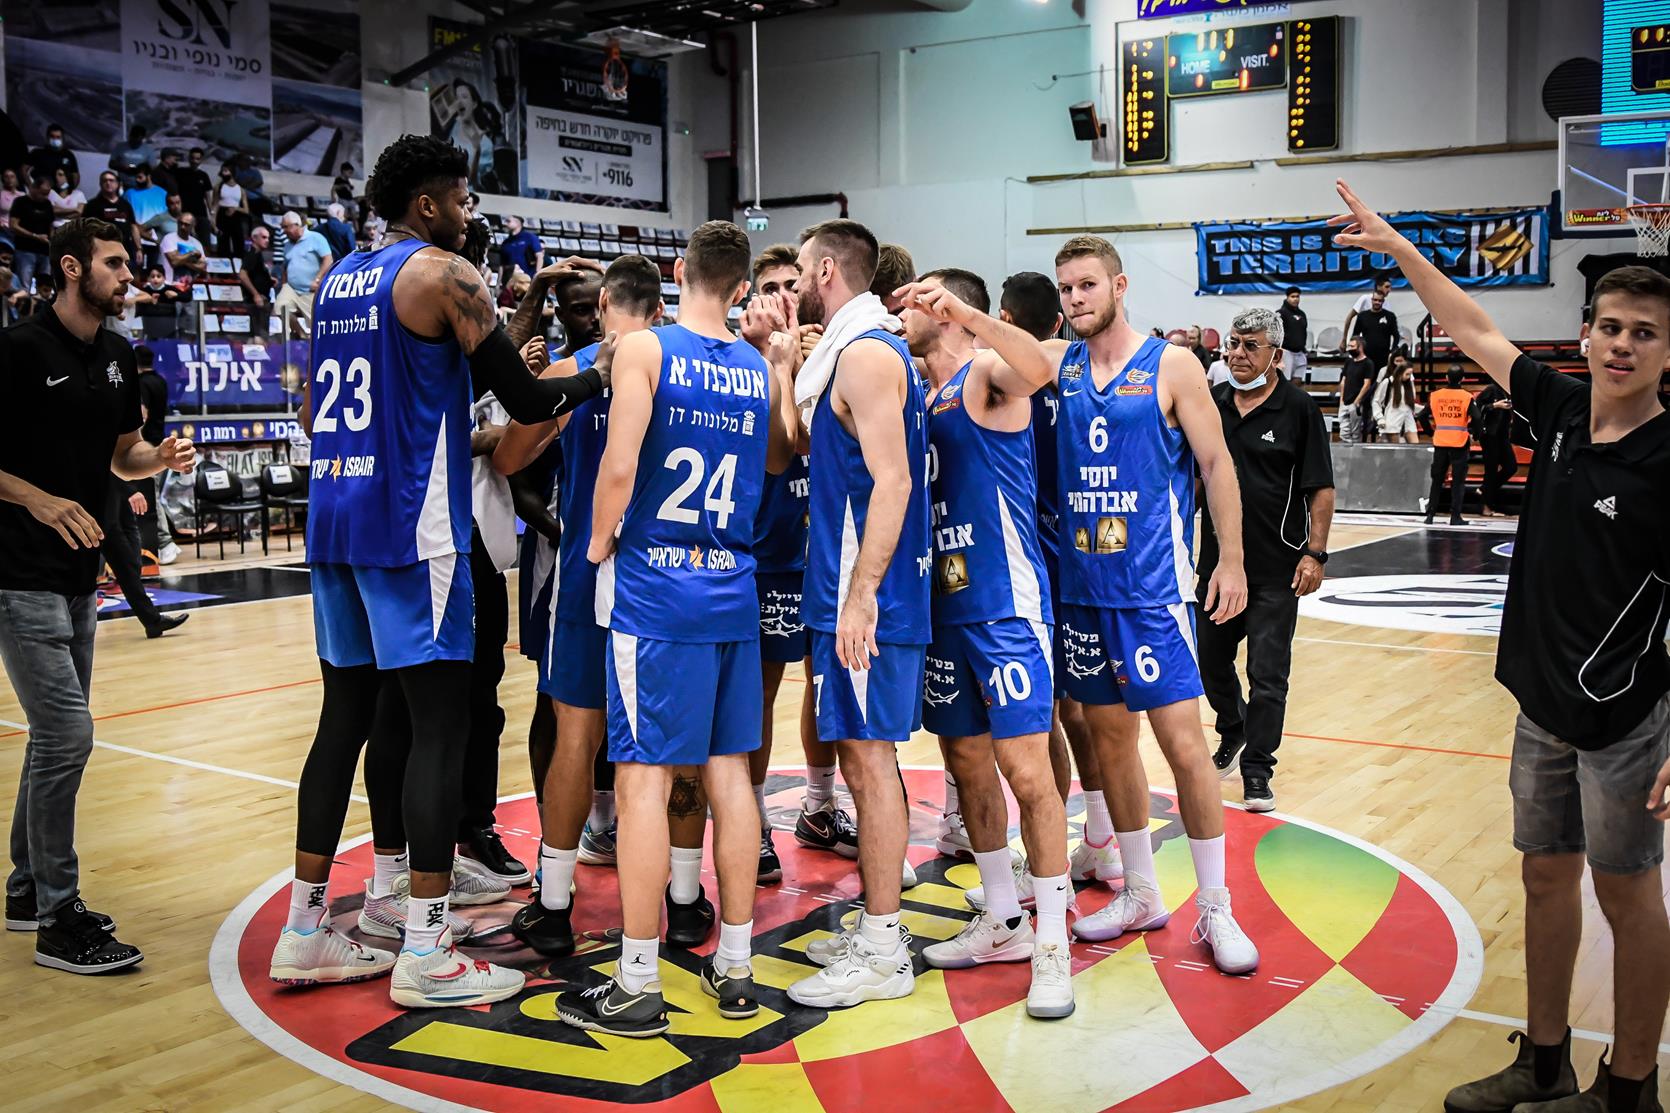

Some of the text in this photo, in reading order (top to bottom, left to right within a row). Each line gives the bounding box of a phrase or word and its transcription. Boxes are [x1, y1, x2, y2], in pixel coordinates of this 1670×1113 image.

[157, 0, 234, 49] SN
[133, 40, 178, 60] ובניו
[184, 48, 220, 68] נופי
[227, 55, 262, 73] סמי
[1181, 59, 1211, 75] HOME
[536, 115, 567, 133] בחיפה
[569, 120, 591, 136] חדש
[1573, 214, 1611, 223] Winner
[1211, 237, 1283, 253] THIS
[1291, 235, 1323, 250] IS
[319, 266, 384, 305] פאטון
[317, 314, 367, 340] מלונות דן
[185, 353, 263, 392] אילת
[312, 356, 373, 433] 23
[668, 406, 739, 433] מלונות דן
[200, 426, 236, 443] רמת גן
[1088, 416, 1109, 453] 6
[342, 456, 375, 477] ISRAIR
[1079, 466, 1117, 488] יוסי
[656, 447, 738, 529] 24
[1067, 490, 1138, 513] אברהמי
[647, 546, 686, 568] ישראייר
[766, 590, 802, 601] טיילי
[925, 655, 955, 671] מטיי
[1134, 645, 1160, 683] 6
[988, 661, 1032, 707] 10
[426, 901, 446, 927] PEAK
